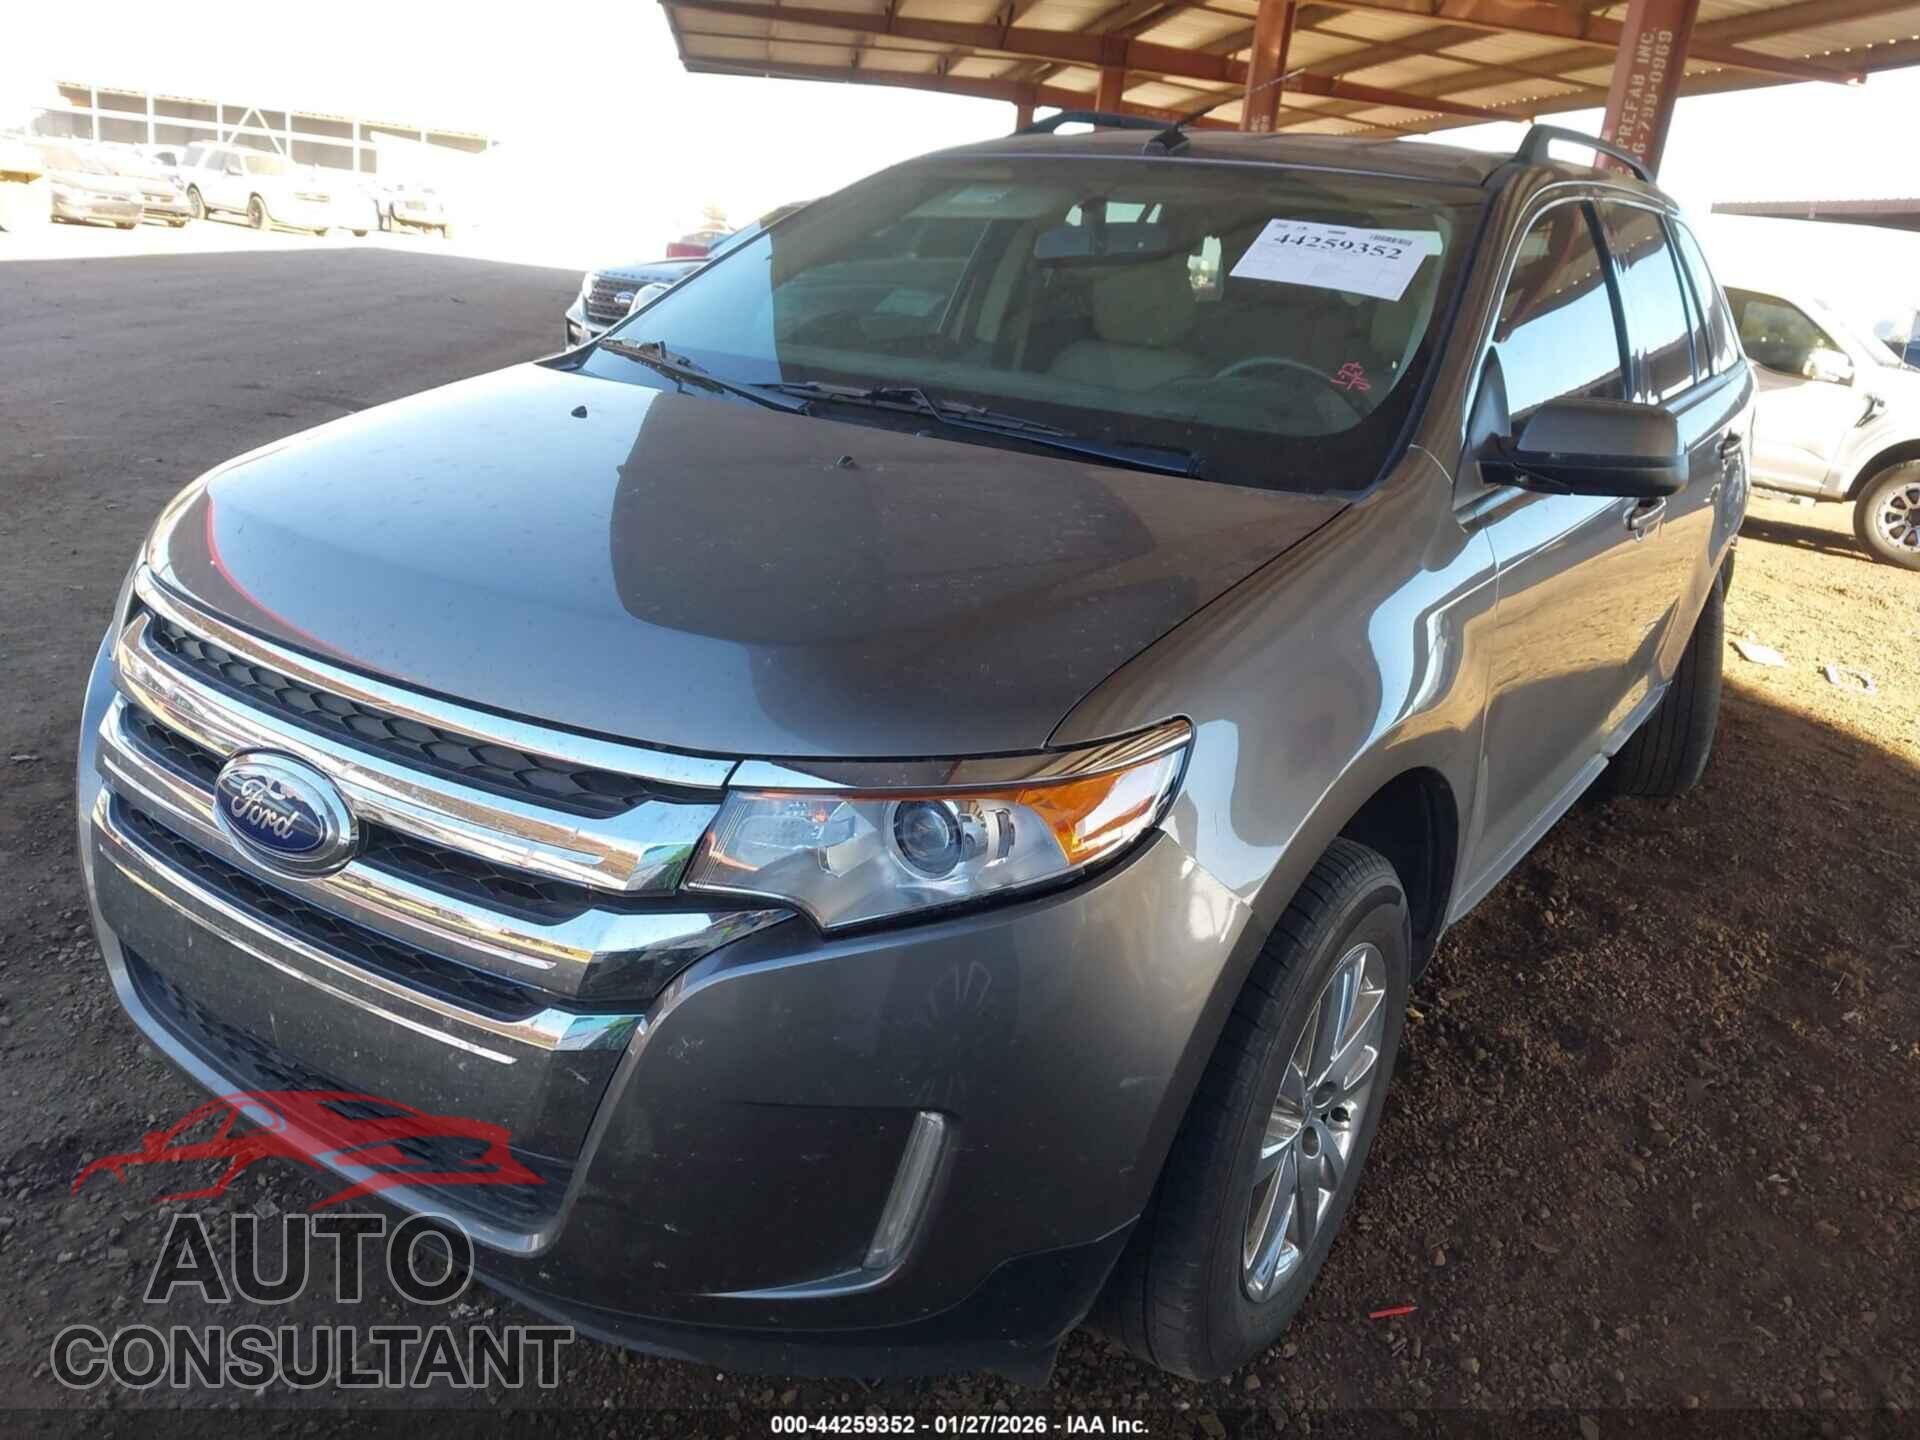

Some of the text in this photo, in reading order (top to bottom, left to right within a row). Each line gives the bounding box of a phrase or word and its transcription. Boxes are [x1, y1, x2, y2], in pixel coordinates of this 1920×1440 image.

[1616, 74, 1645, 149] PREFAB
[1631, 30, 1673, 161] 6-799-0969
[1273, 233, 1402, 260] 44259352
[231, 778, 299, 839] Ford
